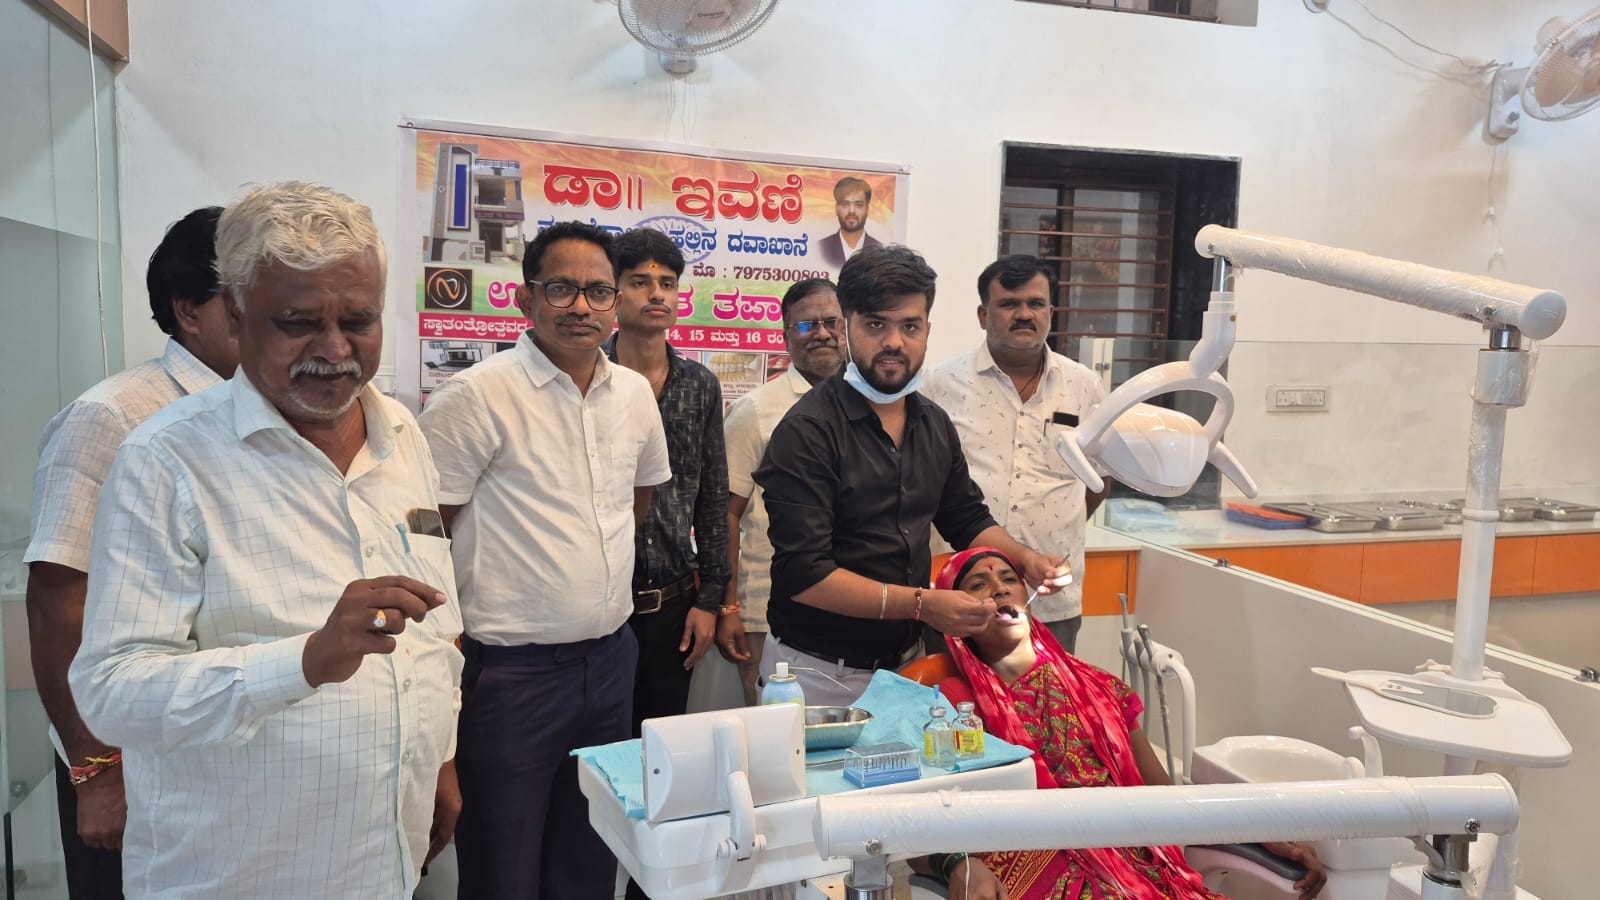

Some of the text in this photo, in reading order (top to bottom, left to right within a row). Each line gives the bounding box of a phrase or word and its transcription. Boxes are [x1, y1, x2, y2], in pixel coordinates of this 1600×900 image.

[671, 170, 804, 223] ಇವಣಿ
[727, 231, 808, 256] ದವಾಖಾನೆ
[733, 266, 830, 282] 7975300803
[689, 329, 704, 341] 15
[710, 329, 739, 346] ಮತ್ತು
[746, 331, 761, 343] 16
